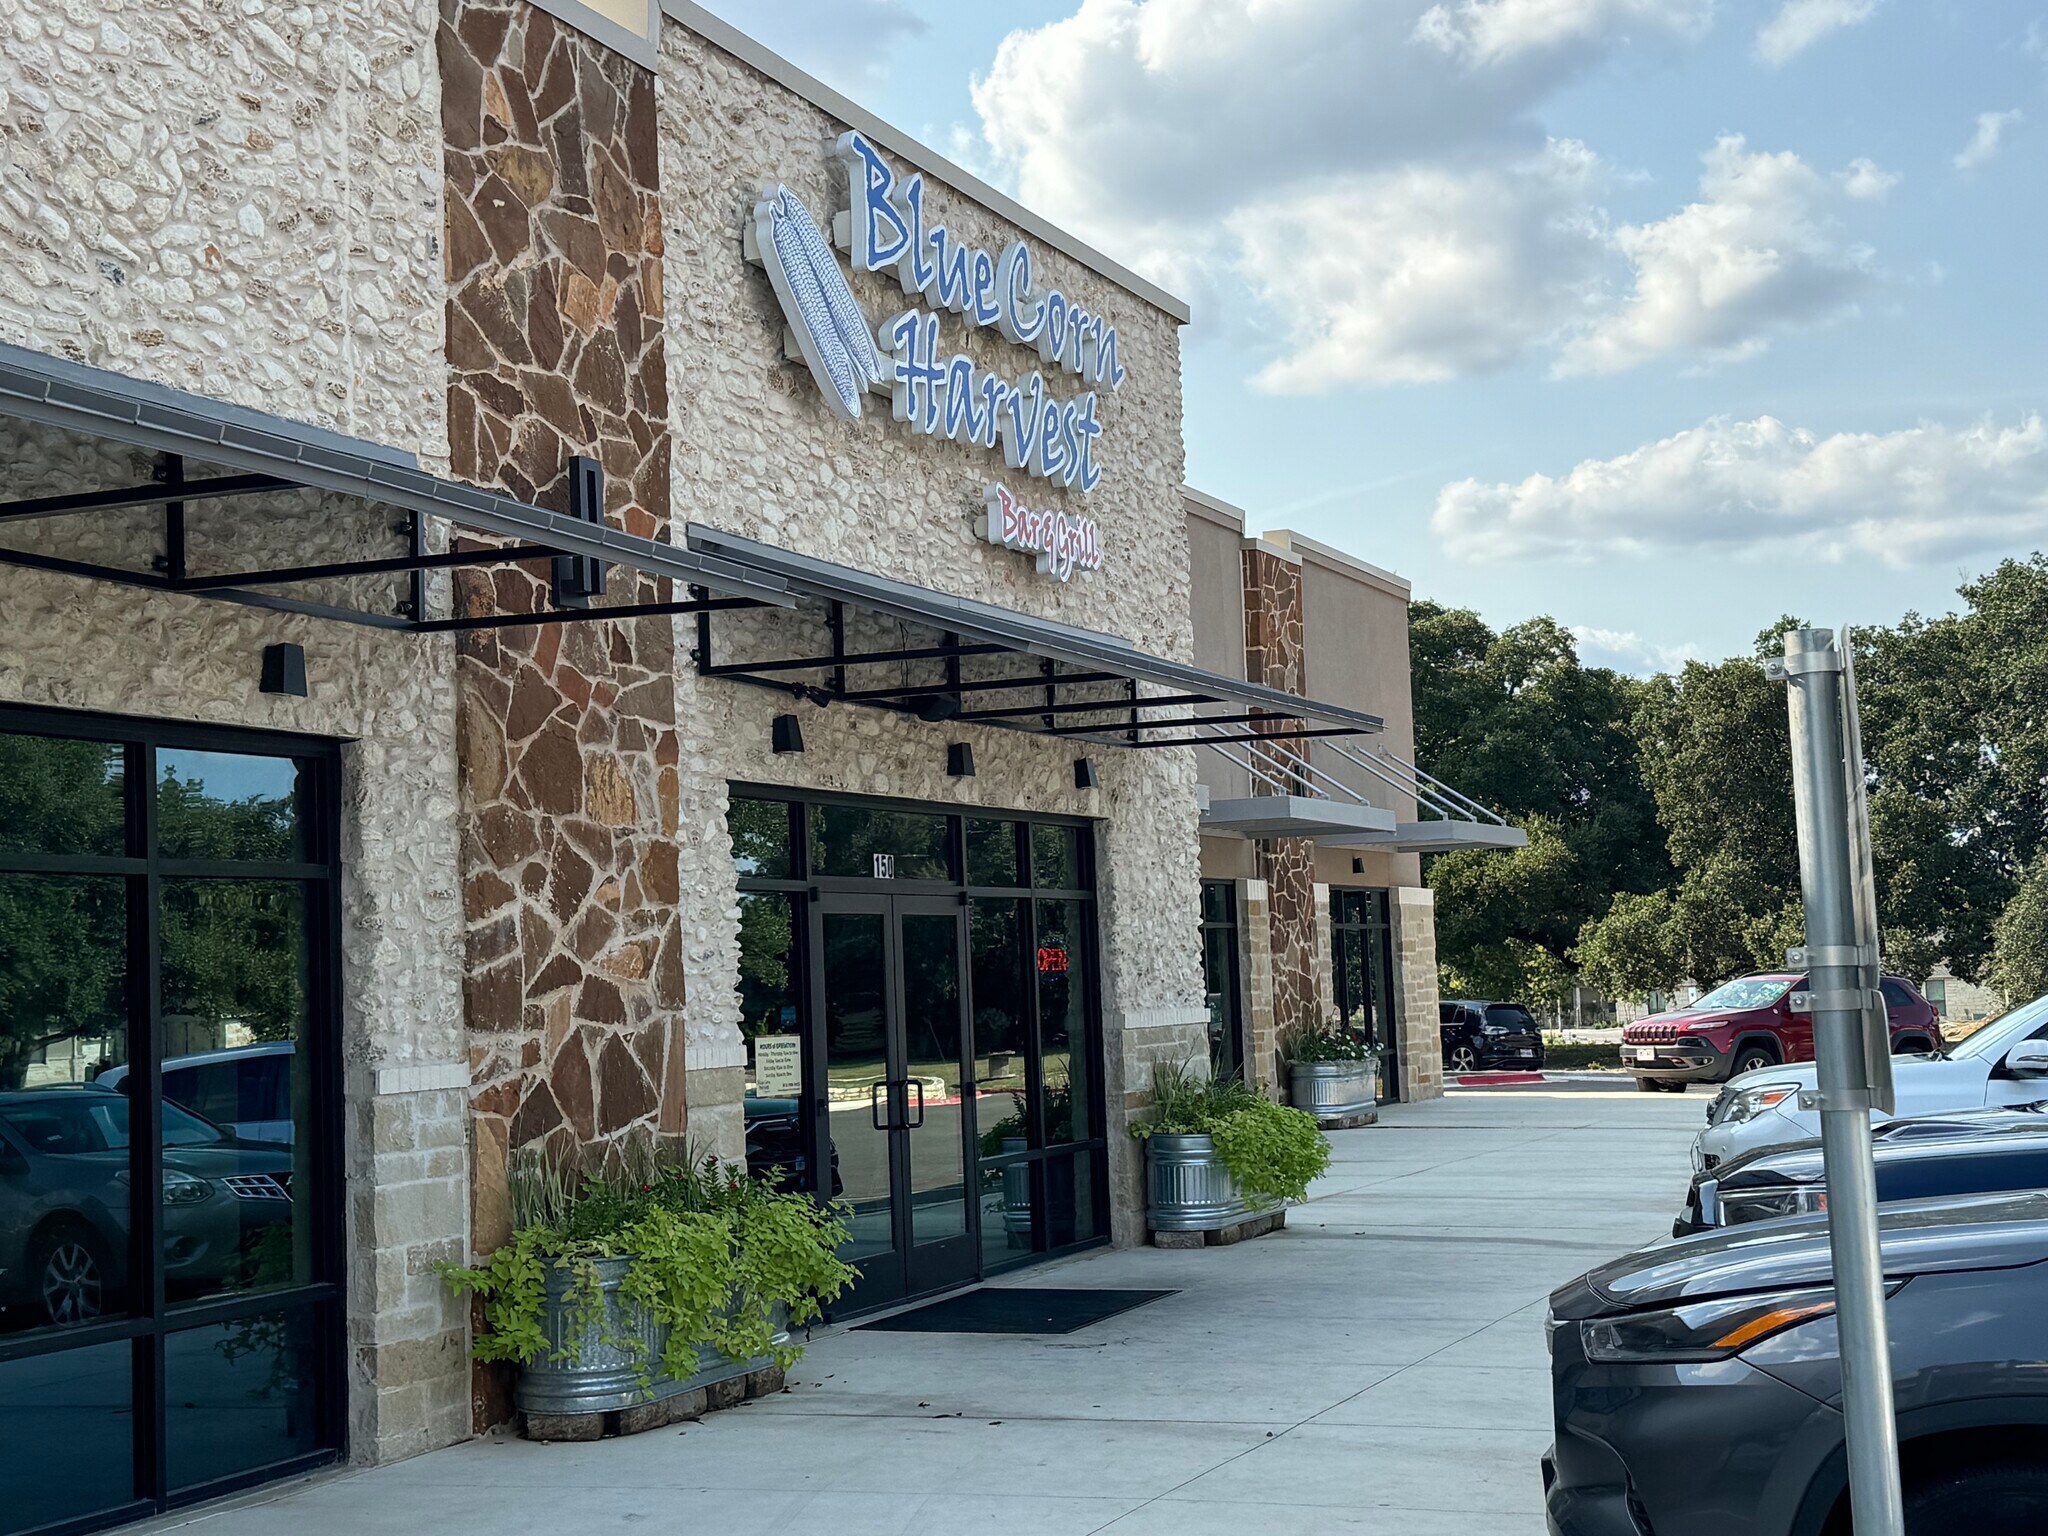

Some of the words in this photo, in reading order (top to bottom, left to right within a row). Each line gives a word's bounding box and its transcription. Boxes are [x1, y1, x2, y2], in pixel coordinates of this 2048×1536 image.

[851, 134, 1000, 326] Blue
[1008, 246, 1125, 390] Corn
[875, 855, 893, 878] 150
[1037, 947, 1068, 971] OPEN
